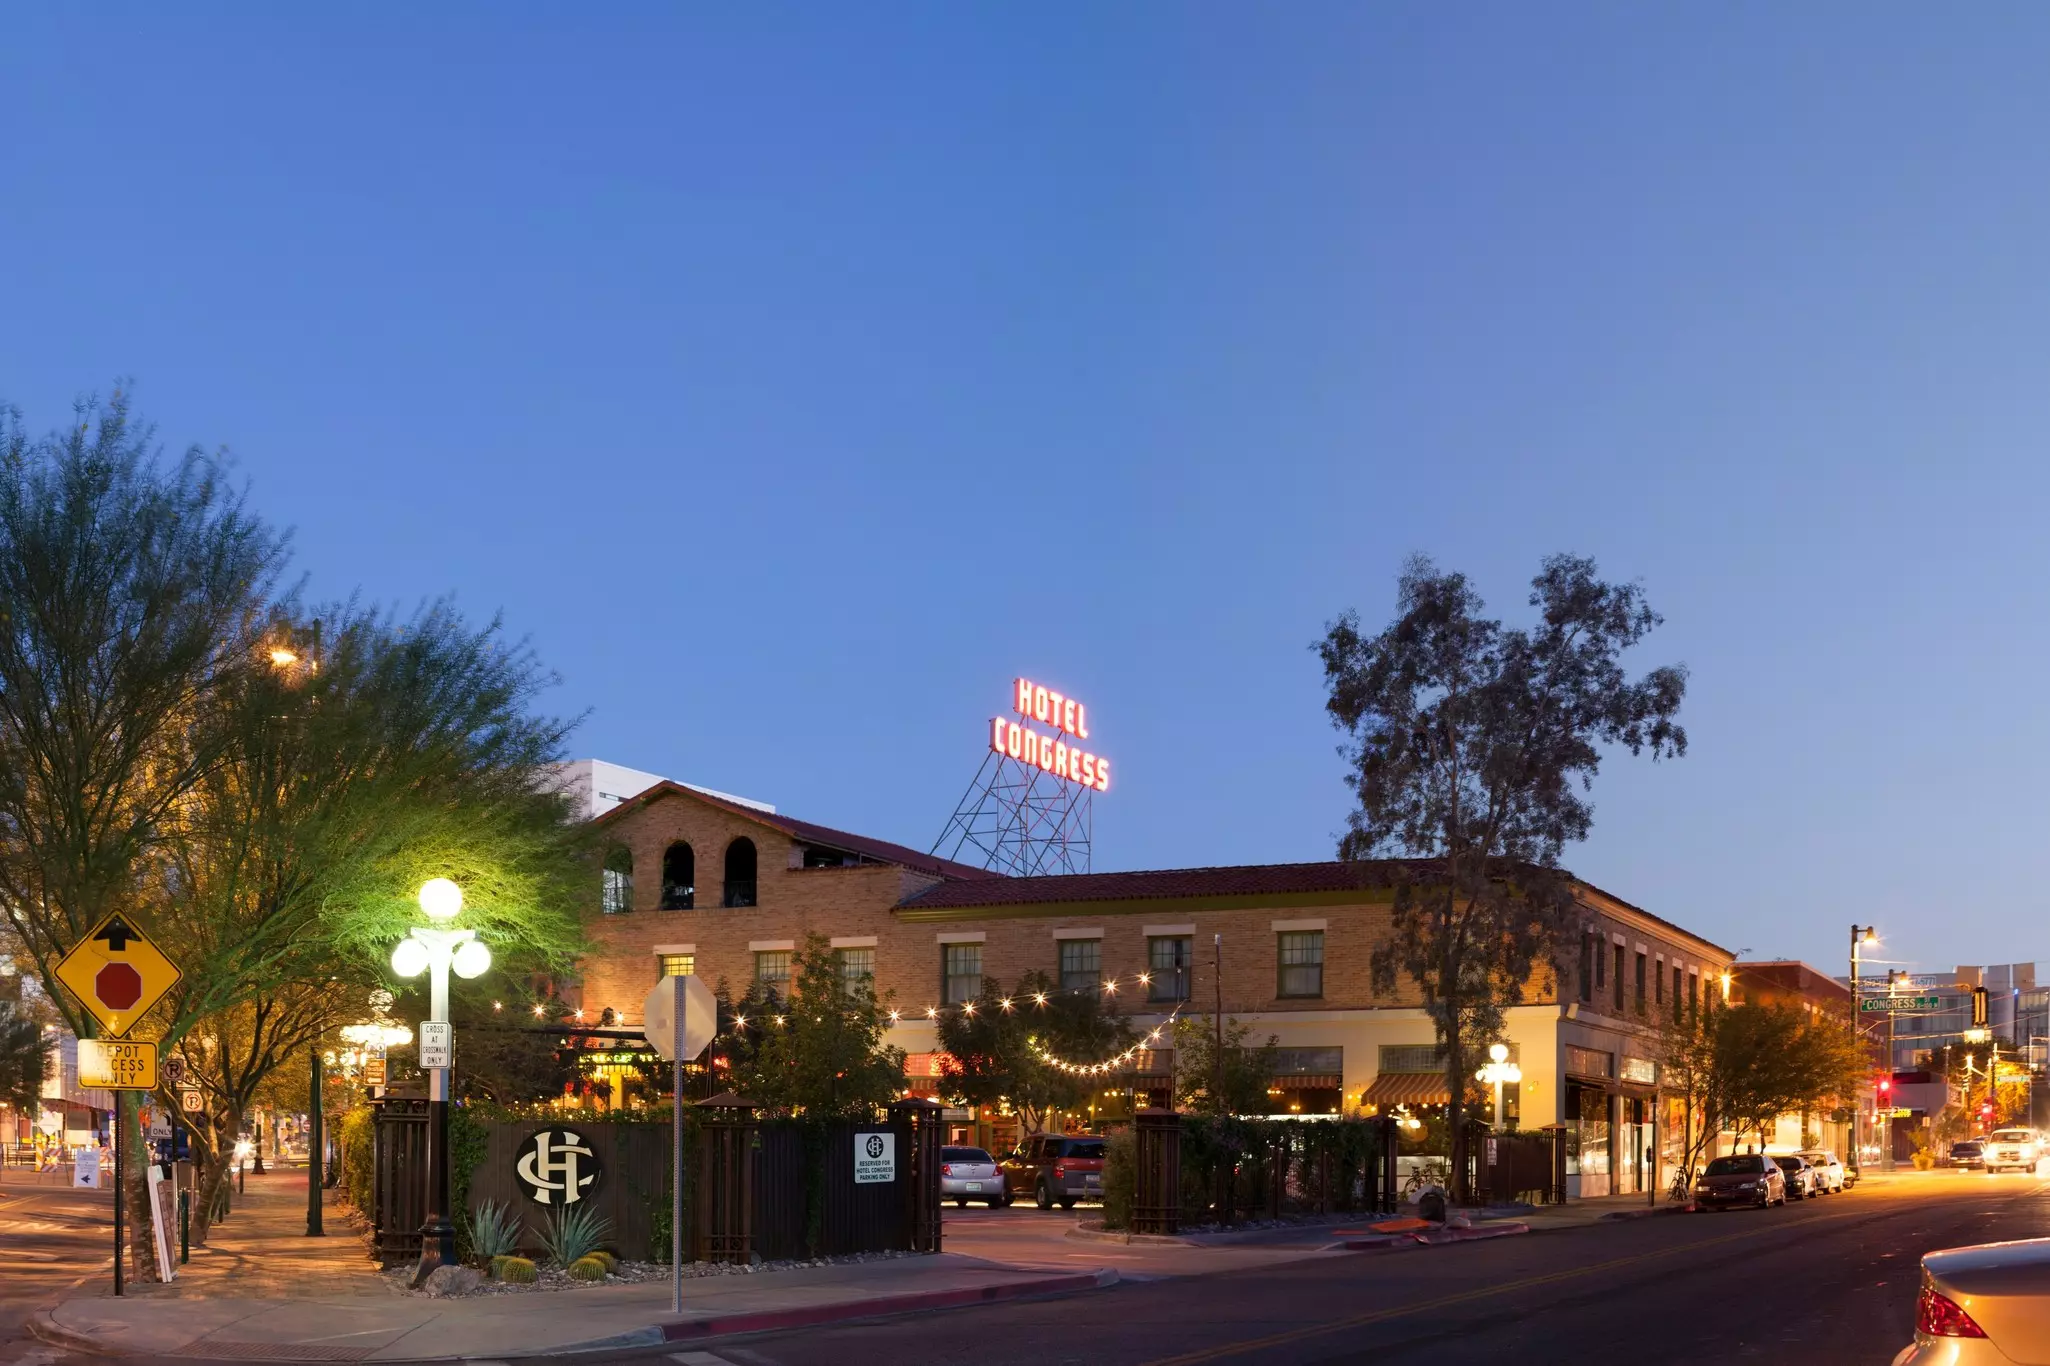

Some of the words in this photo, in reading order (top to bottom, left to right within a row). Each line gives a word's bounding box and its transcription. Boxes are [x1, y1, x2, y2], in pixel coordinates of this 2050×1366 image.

[1015, 677, 1088, 739] HOTEL
[991, 716, 1110, 792] CONGRESS
[1866, 999, 1916, 1010] CONGRESS
[426, 1025, 444, 1034] CROSS
[97, 1045, 139, 1058] DEPOT
[423, 1046, 447, 1054] CROSSWALK
[95, 1059, 145, 1072] CESS
[427, 1056, 442, 1064] ONLY
[101, 1072, 136, 1085] ONLY
[152, 1128, 172, 1136] ONLY
